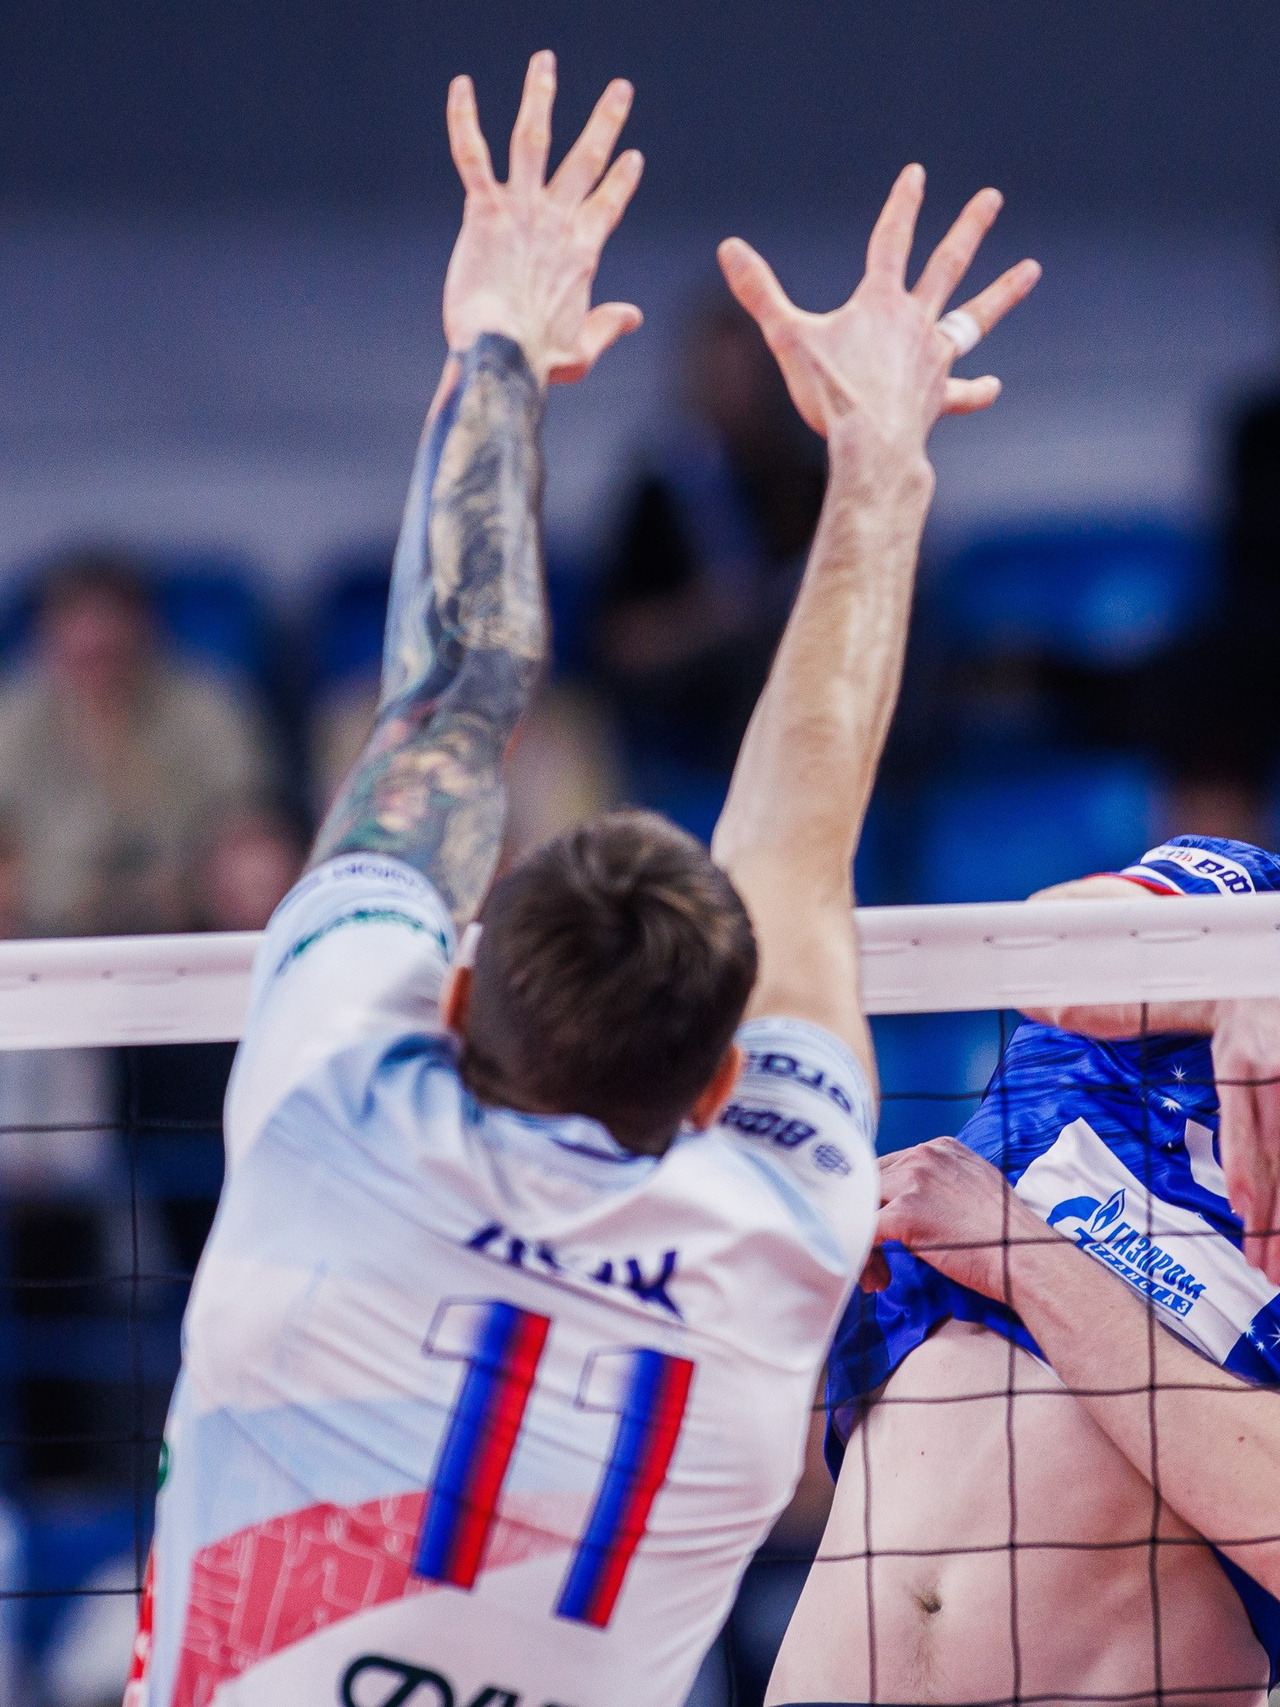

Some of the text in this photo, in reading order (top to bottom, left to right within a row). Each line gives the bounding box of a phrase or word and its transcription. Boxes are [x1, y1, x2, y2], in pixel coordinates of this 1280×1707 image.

[1091, 1244, 1192, 1316] ТРАНСГАЗ
[1101, 1220, 1208, 1301] ГАЗПРОМ
[421, 1296, 696, 1631] 11
